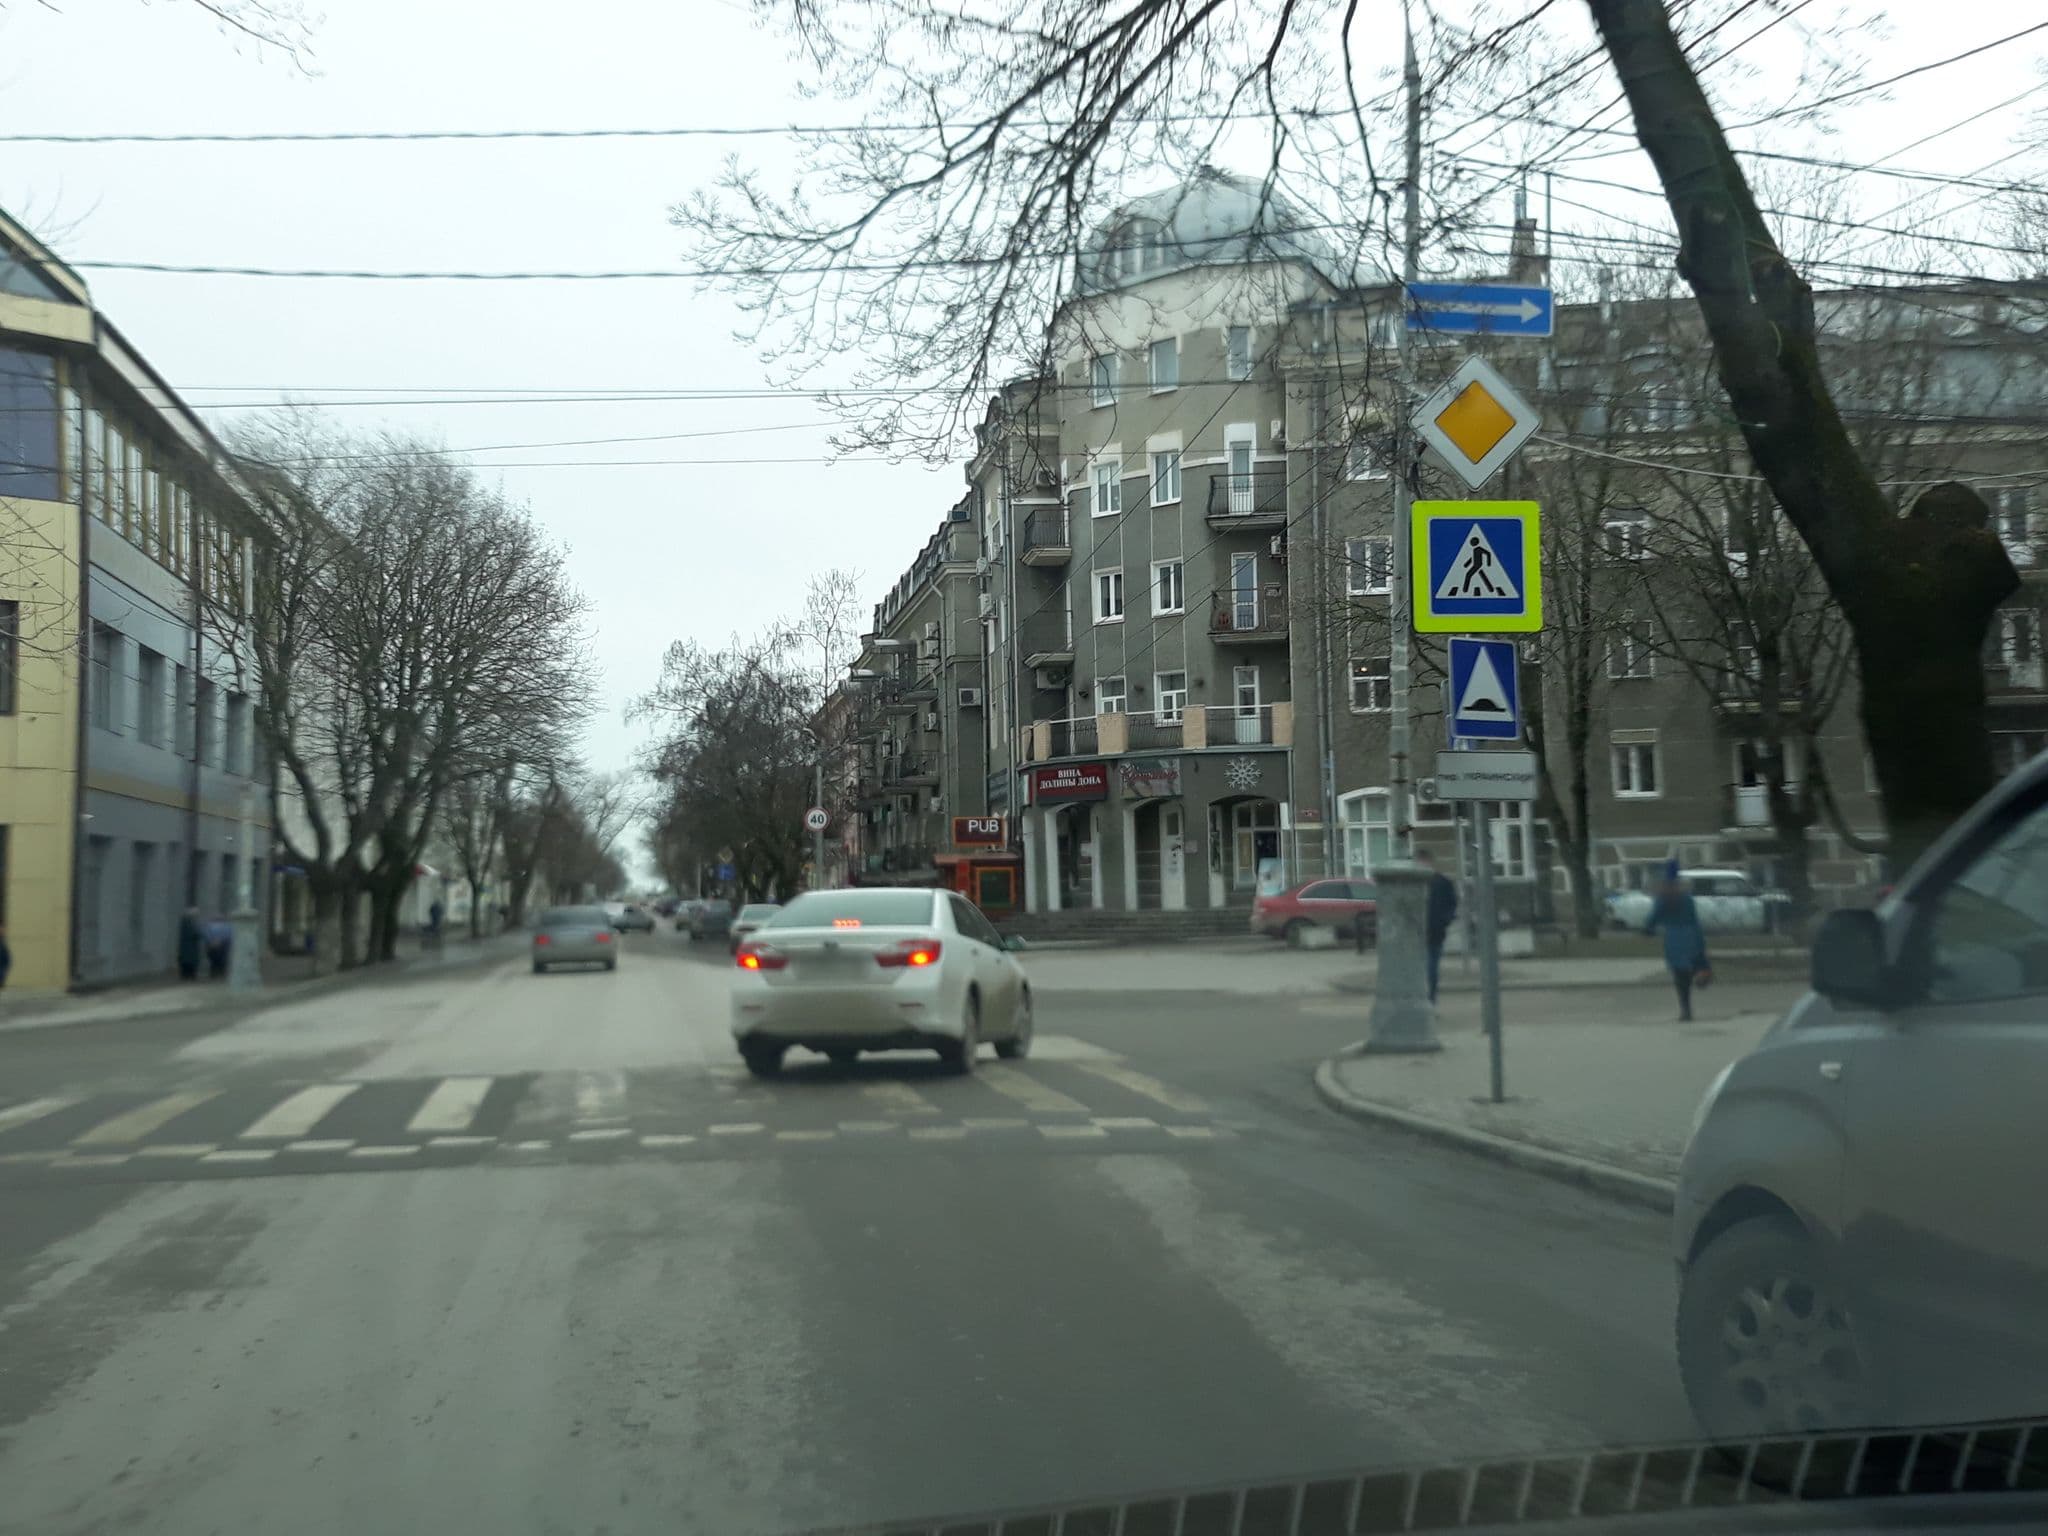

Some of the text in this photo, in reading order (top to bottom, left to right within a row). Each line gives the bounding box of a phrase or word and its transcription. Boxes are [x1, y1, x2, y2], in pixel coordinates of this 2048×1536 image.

[1058, 768, 1081, 778] ВИНА
[1040, 776, 1101, 789] ДОЛИНЫ ДОНА
[810, 814, 825, 825] 40
[968, 819, 999, 833] PUB
